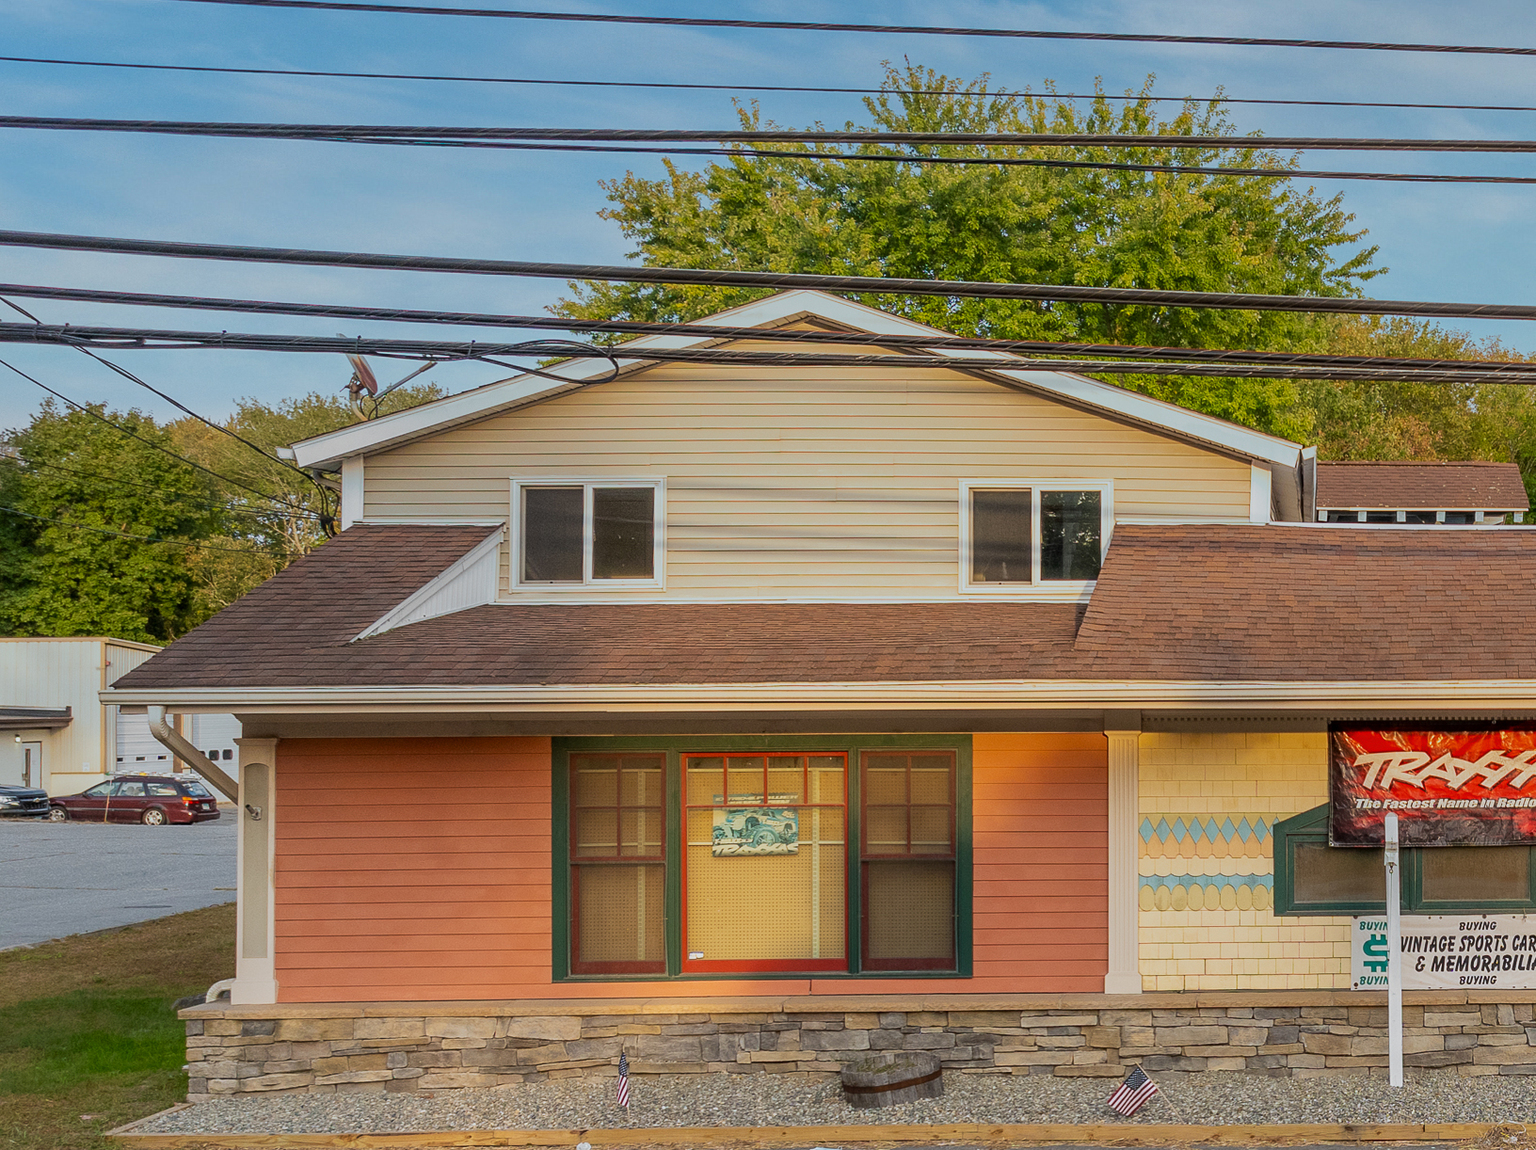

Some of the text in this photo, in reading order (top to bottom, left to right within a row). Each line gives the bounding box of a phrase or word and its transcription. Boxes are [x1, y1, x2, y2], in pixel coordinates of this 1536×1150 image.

[1355, 798, 1382, 809] The
[1383, 798, 1436, 809] Fastest
[1437, 798, 1478, 809] Name
[1480, 798, 1496, 808] In
[1359, 921, 1388, 931] BUYIN
[1459, 921, 1498, 931] BUYING
[1400, 935, 1457, 953] VINTAGE
[1459, 934, 1509, 953] SPORTS
[1415, 955, 1426, 972] &
[1359, 976, 1389, 985] BUYIN
[1459, 975, 1498, 985] BUYING
